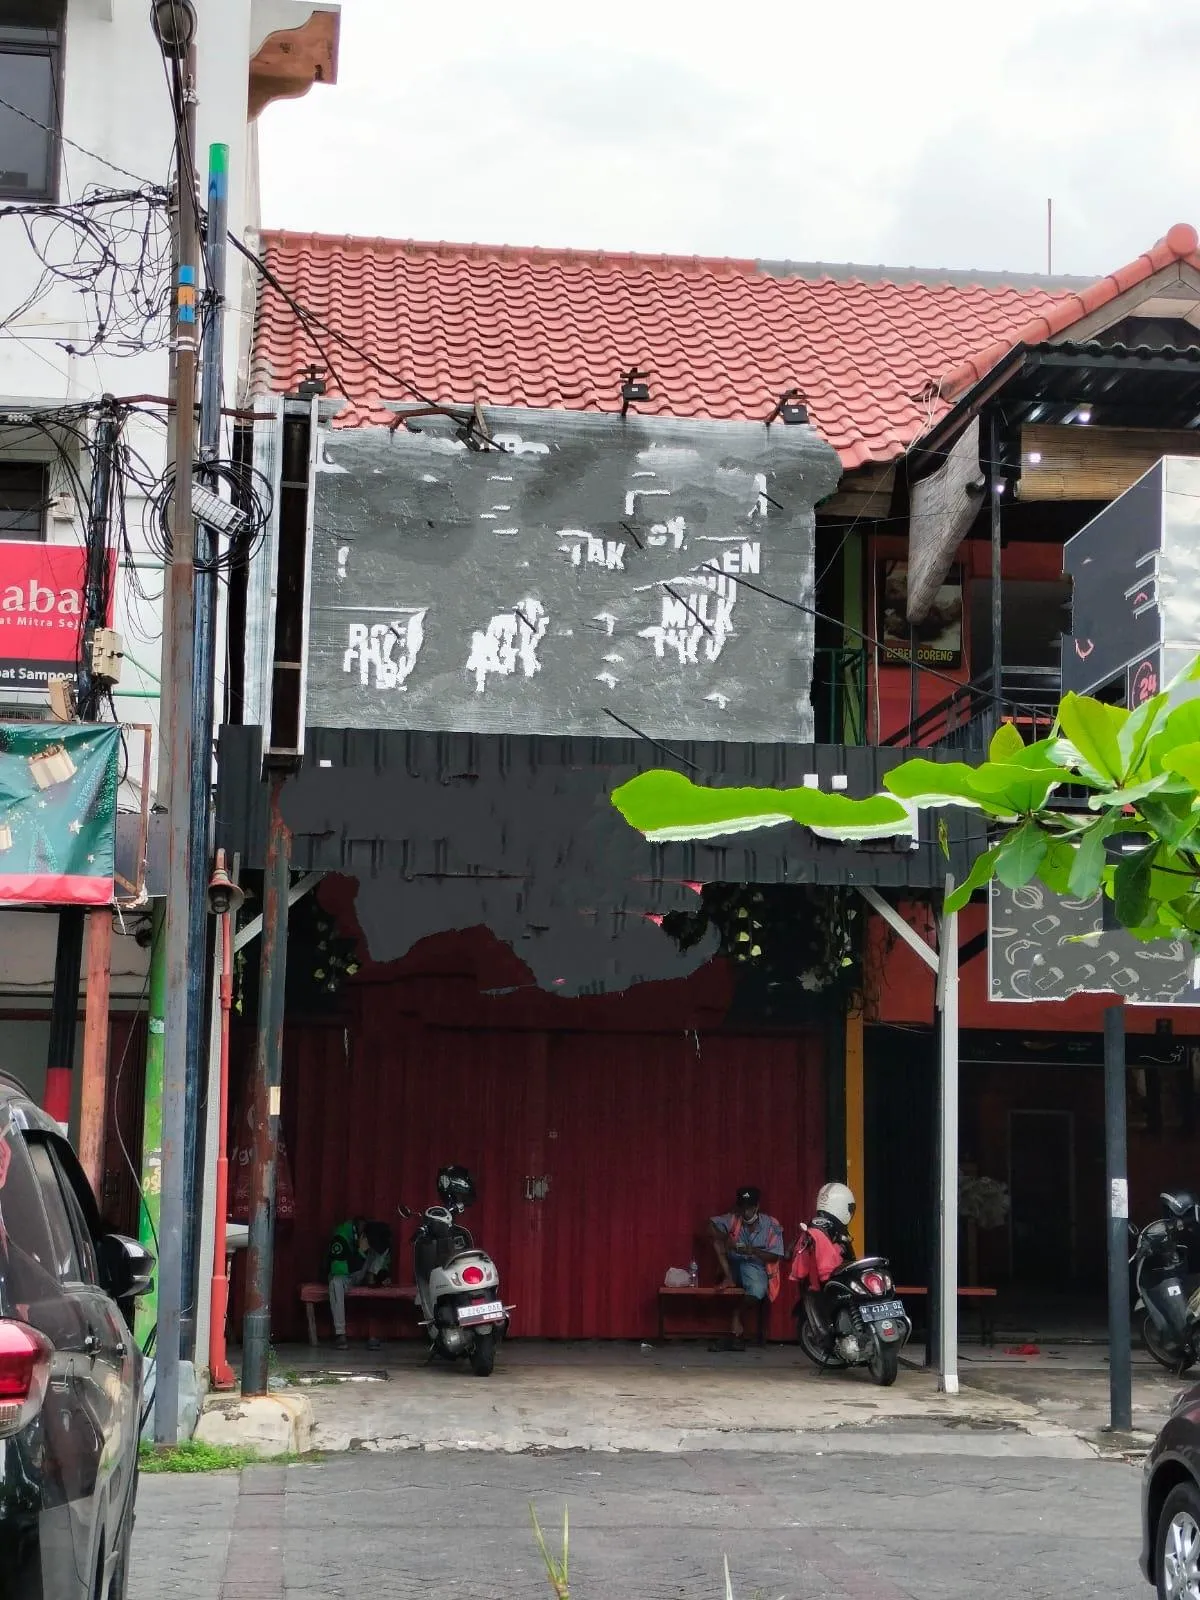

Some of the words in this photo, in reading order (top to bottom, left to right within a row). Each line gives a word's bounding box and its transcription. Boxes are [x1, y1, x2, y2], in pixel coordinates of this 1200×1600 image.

[2, 579, 88, 615] aba
[17, 616, 53, 628] Mitra
[59, 618, 83, 631] Sej
[917, 649, 954, 662] GORENG
[0, 668, 15, 679] at
